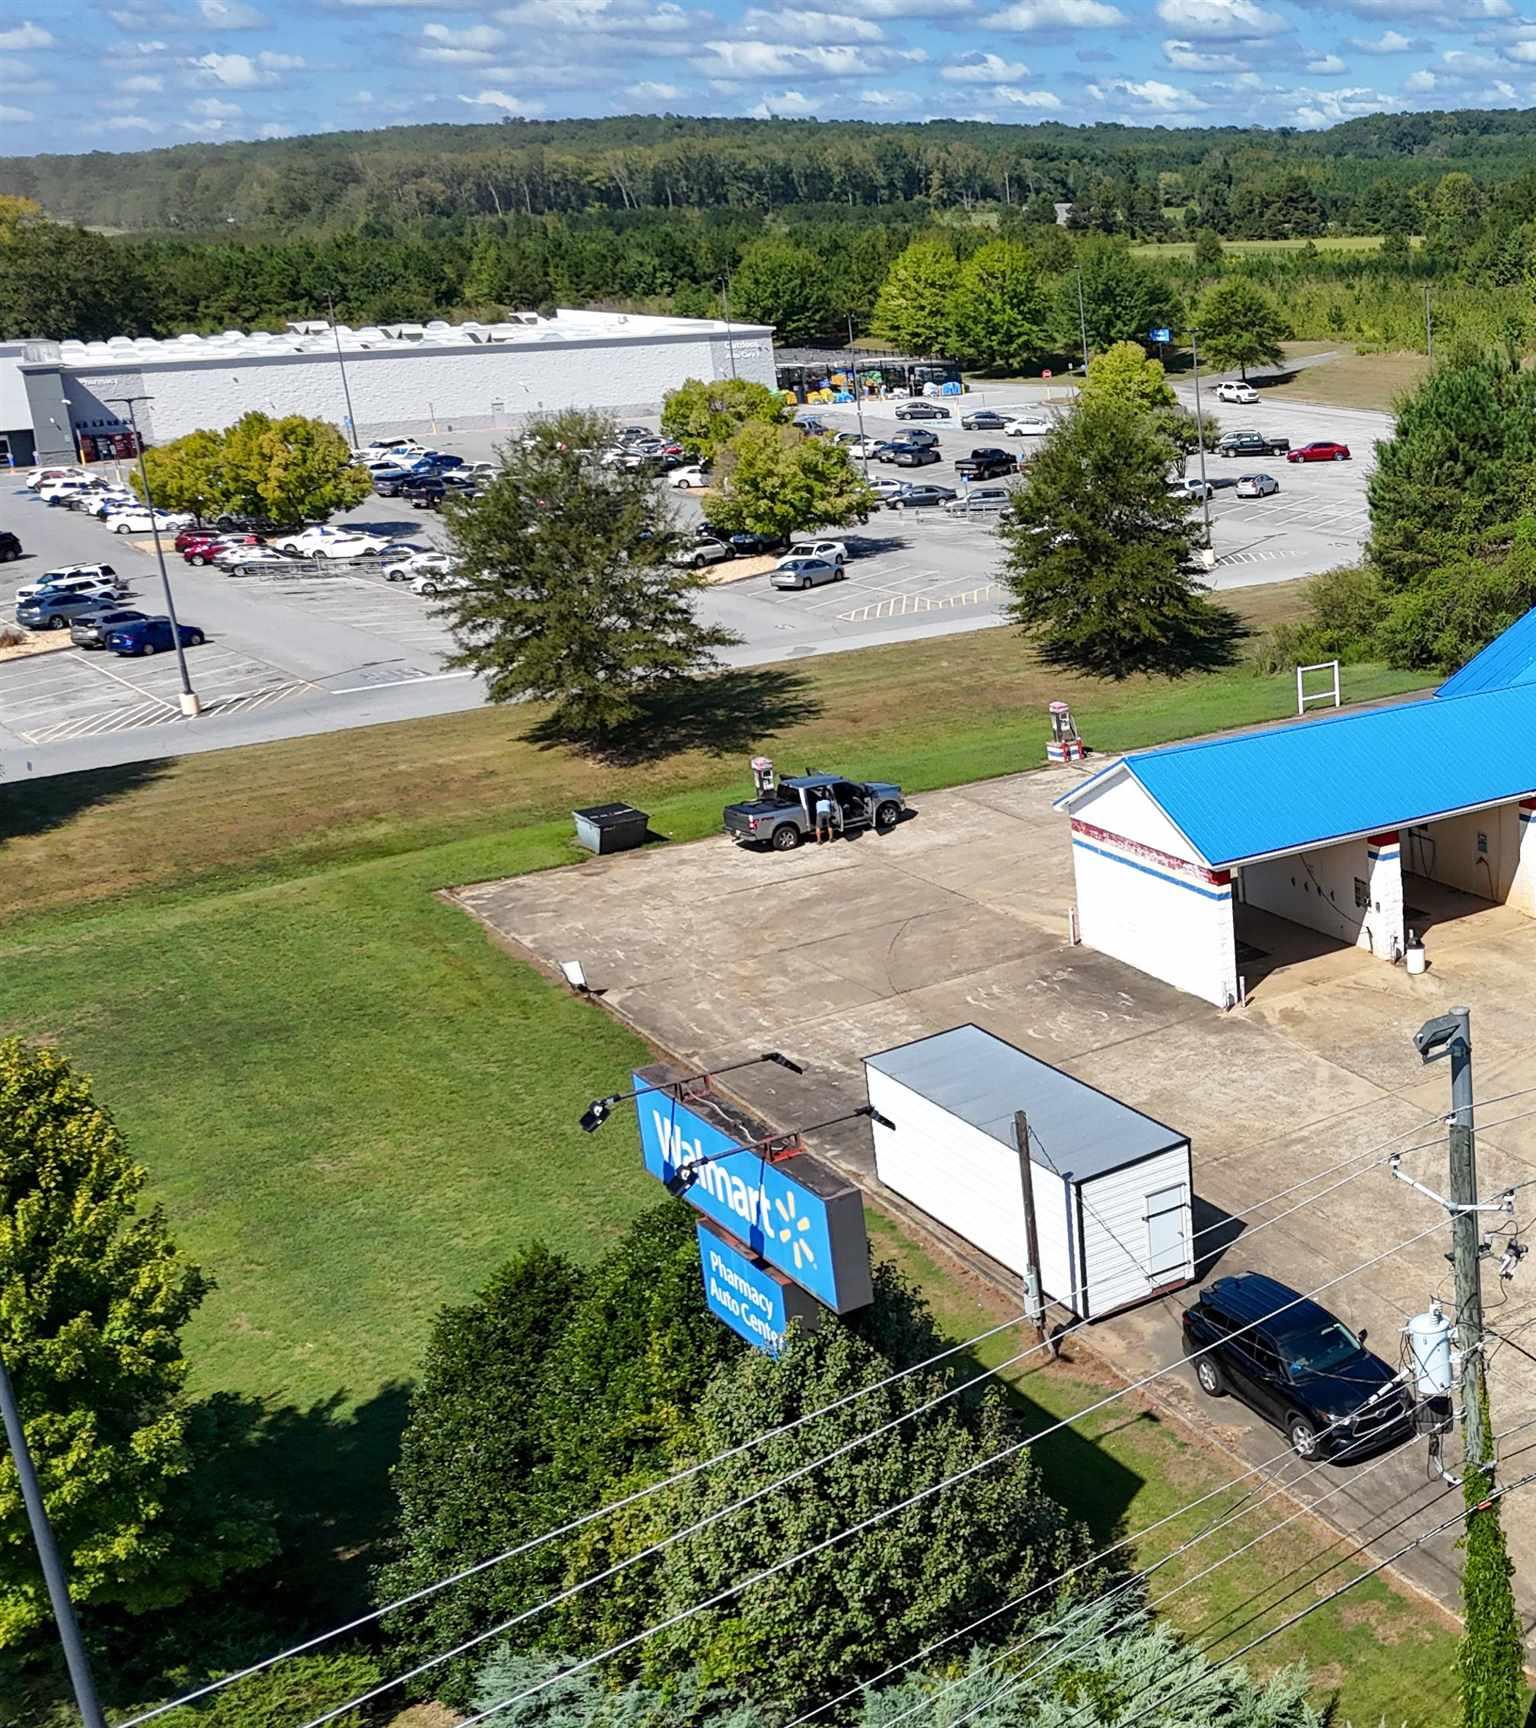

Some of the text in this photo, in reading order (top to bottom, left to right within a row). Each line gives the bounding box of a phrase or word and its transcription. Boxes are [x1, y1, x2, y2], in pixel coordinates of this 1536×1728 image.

[653, 1110, 775, 1239] Walmart
[710, 1250, 773, 1320] Pharmacy
[710, 1276, 740, 1316] Auto
